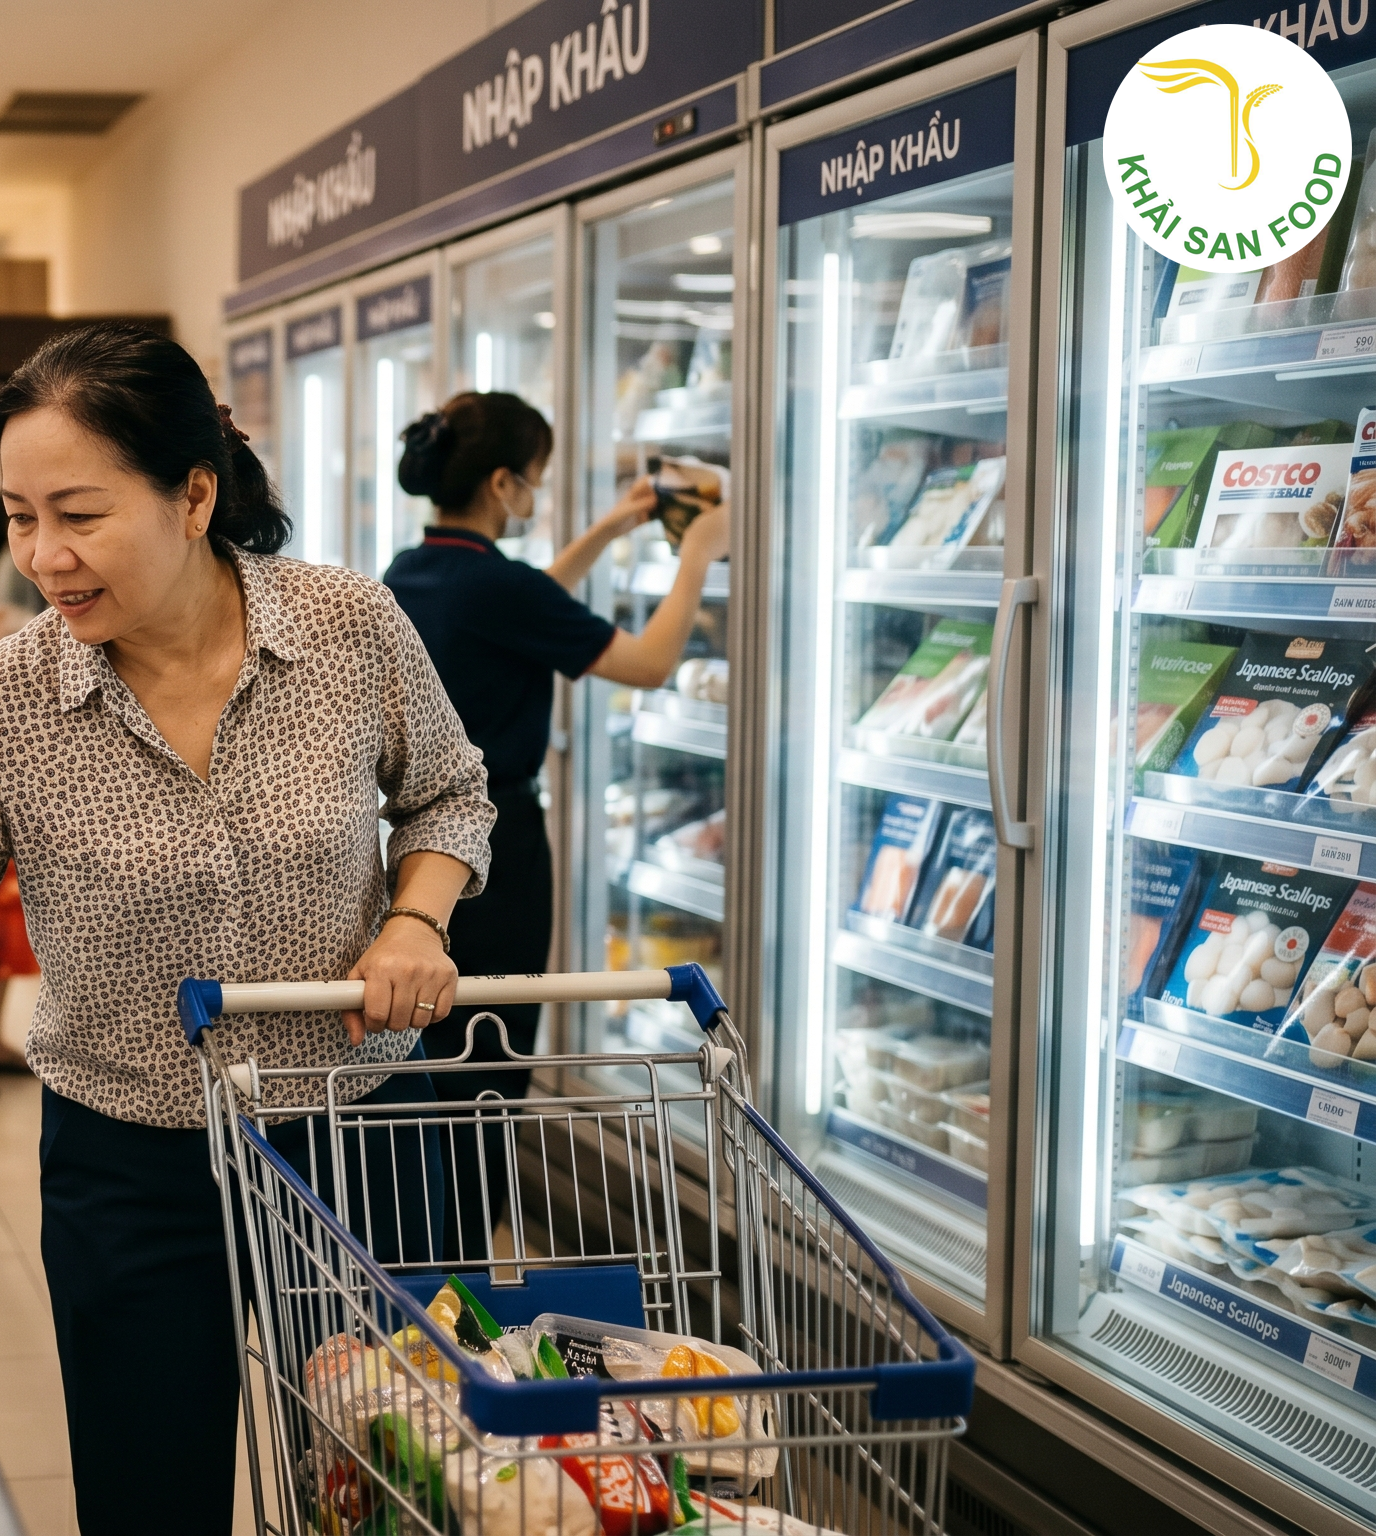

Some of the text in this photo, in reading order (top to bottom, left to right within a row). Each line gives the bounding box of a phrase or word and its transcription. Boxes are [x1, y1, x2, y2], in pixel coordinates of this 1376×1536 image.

[463, 48, 544, 154] NHẬP
[821, 110, 961, 196] NHẬP KHẨU
[1223, 461, 1321, 487] COSTCO
[1236, 658, 1297, 682] Japanese
[1297, 664, 1355, 690] Scallops
[1219, 872, 1276, 897] Japanese
[1276, 883, 1332, 912] Scallops
[1167, 1274, 1280, 1340] Japanese Scallops
